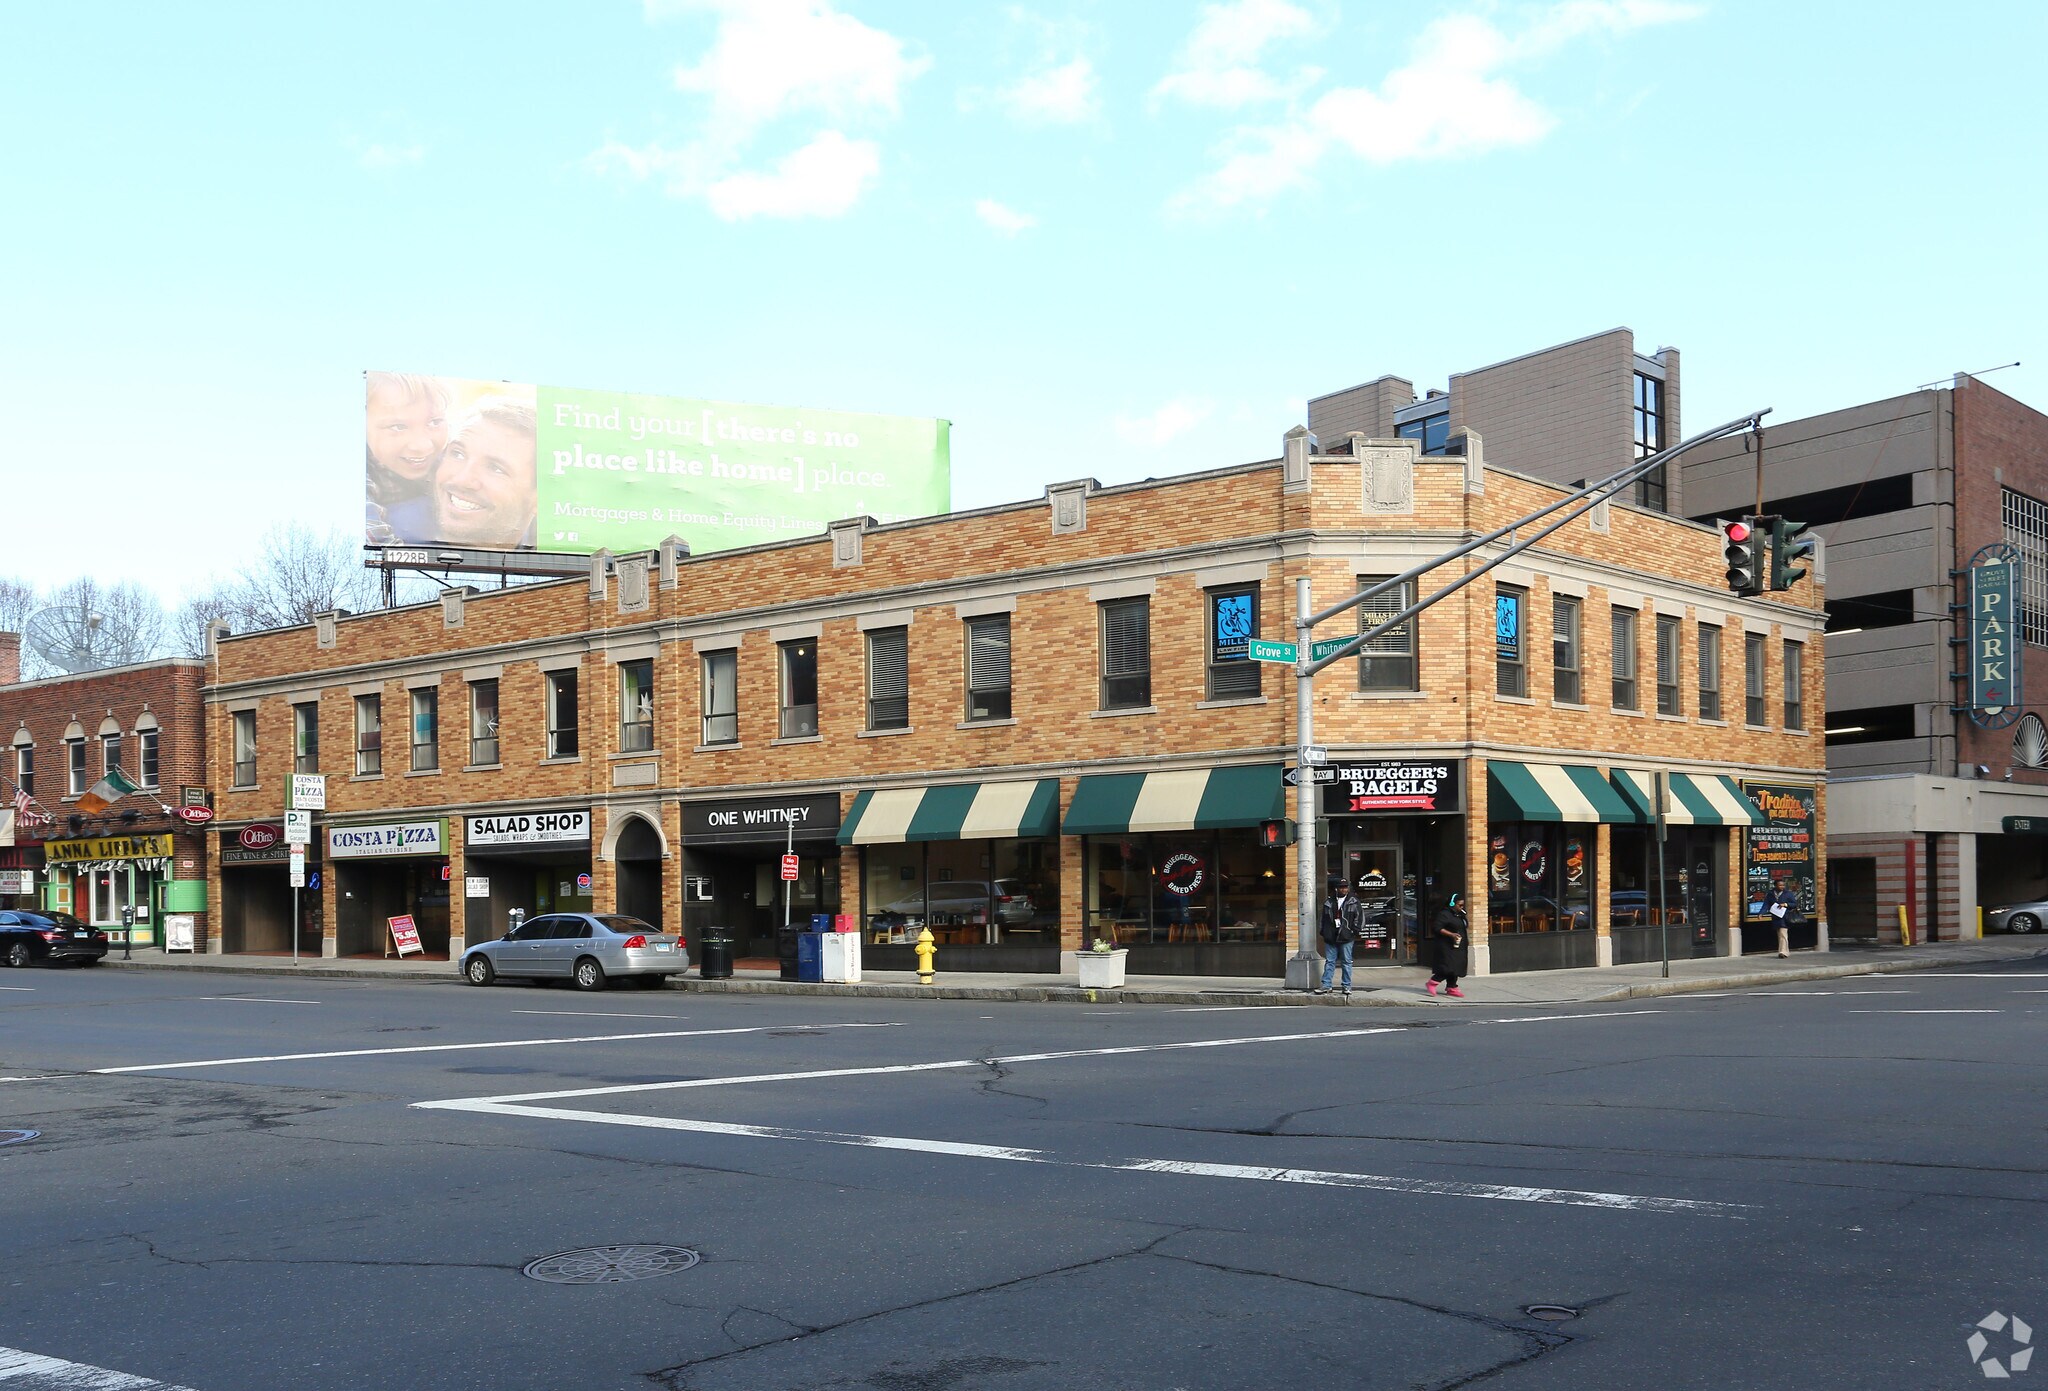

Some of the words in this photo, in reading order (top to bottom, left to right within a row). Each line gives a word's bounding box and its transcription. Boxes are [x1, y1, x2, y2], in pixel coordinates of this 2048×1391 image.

[553, 403, 622, 431] Find
[627, 414, 696, 441] your
[824, 430, 860, 448] no
[553, 444, 639, 475] place
[645, 448, 704, 476] like
[812, 461, 892, 492] place.
[553, 501, 648, 525] Mortgages
[651, 507, 664, 521] &
[667, 508, 719, 525] Home
[722, 512, 776, 533] Equity
[389, 551, 427, 564] 1228B
[979, 574, 1006, 583] STREET
[980, 568, 1005, 577] GROVE
[978, 580, 1007, 589] GARAGE
[1219, 636, 1251, 647] MILLS
[1497, 636, 1516, 646] MILLS
[1981, 592, 2006, 682] PARK
[1256, 644, 1281, 658] Grove
[1284, 647, 1291, 656] St
[296, 776, 322, 784] COSTA
[1339, 766, 1448, 780] BRUEGGER'S
[294, 785, 323, 797] PIZZA
[1350, 779, 1438, 796] BAGELS
[708, 811, 738, 826] ONE
[742, 806, 810, 824] WHITNEY
[474, 817, 530, 835] SALAD
[536, 813, 583, 832] SHOP
[332, 831, 383, 847] COSTA
[386, 826, 437, 846] PIZZA
[512, 833, 529, 841] WRAPS
[537, 831, 562, 841] SMOOTHIES
[53, 843, 93, 860] ANNA
[226, 852, 241, 861] FINE
[242, 851, 260, 860] WINE
[261, 851, 268, 859] &
[1163, 853, 1198, 874] BRUEGGER'S
[1167, 882, 1190, 894] BAKED
[1188, 870, 1203, 891] FRESH
[395, 930, 416, 940] $5.95
